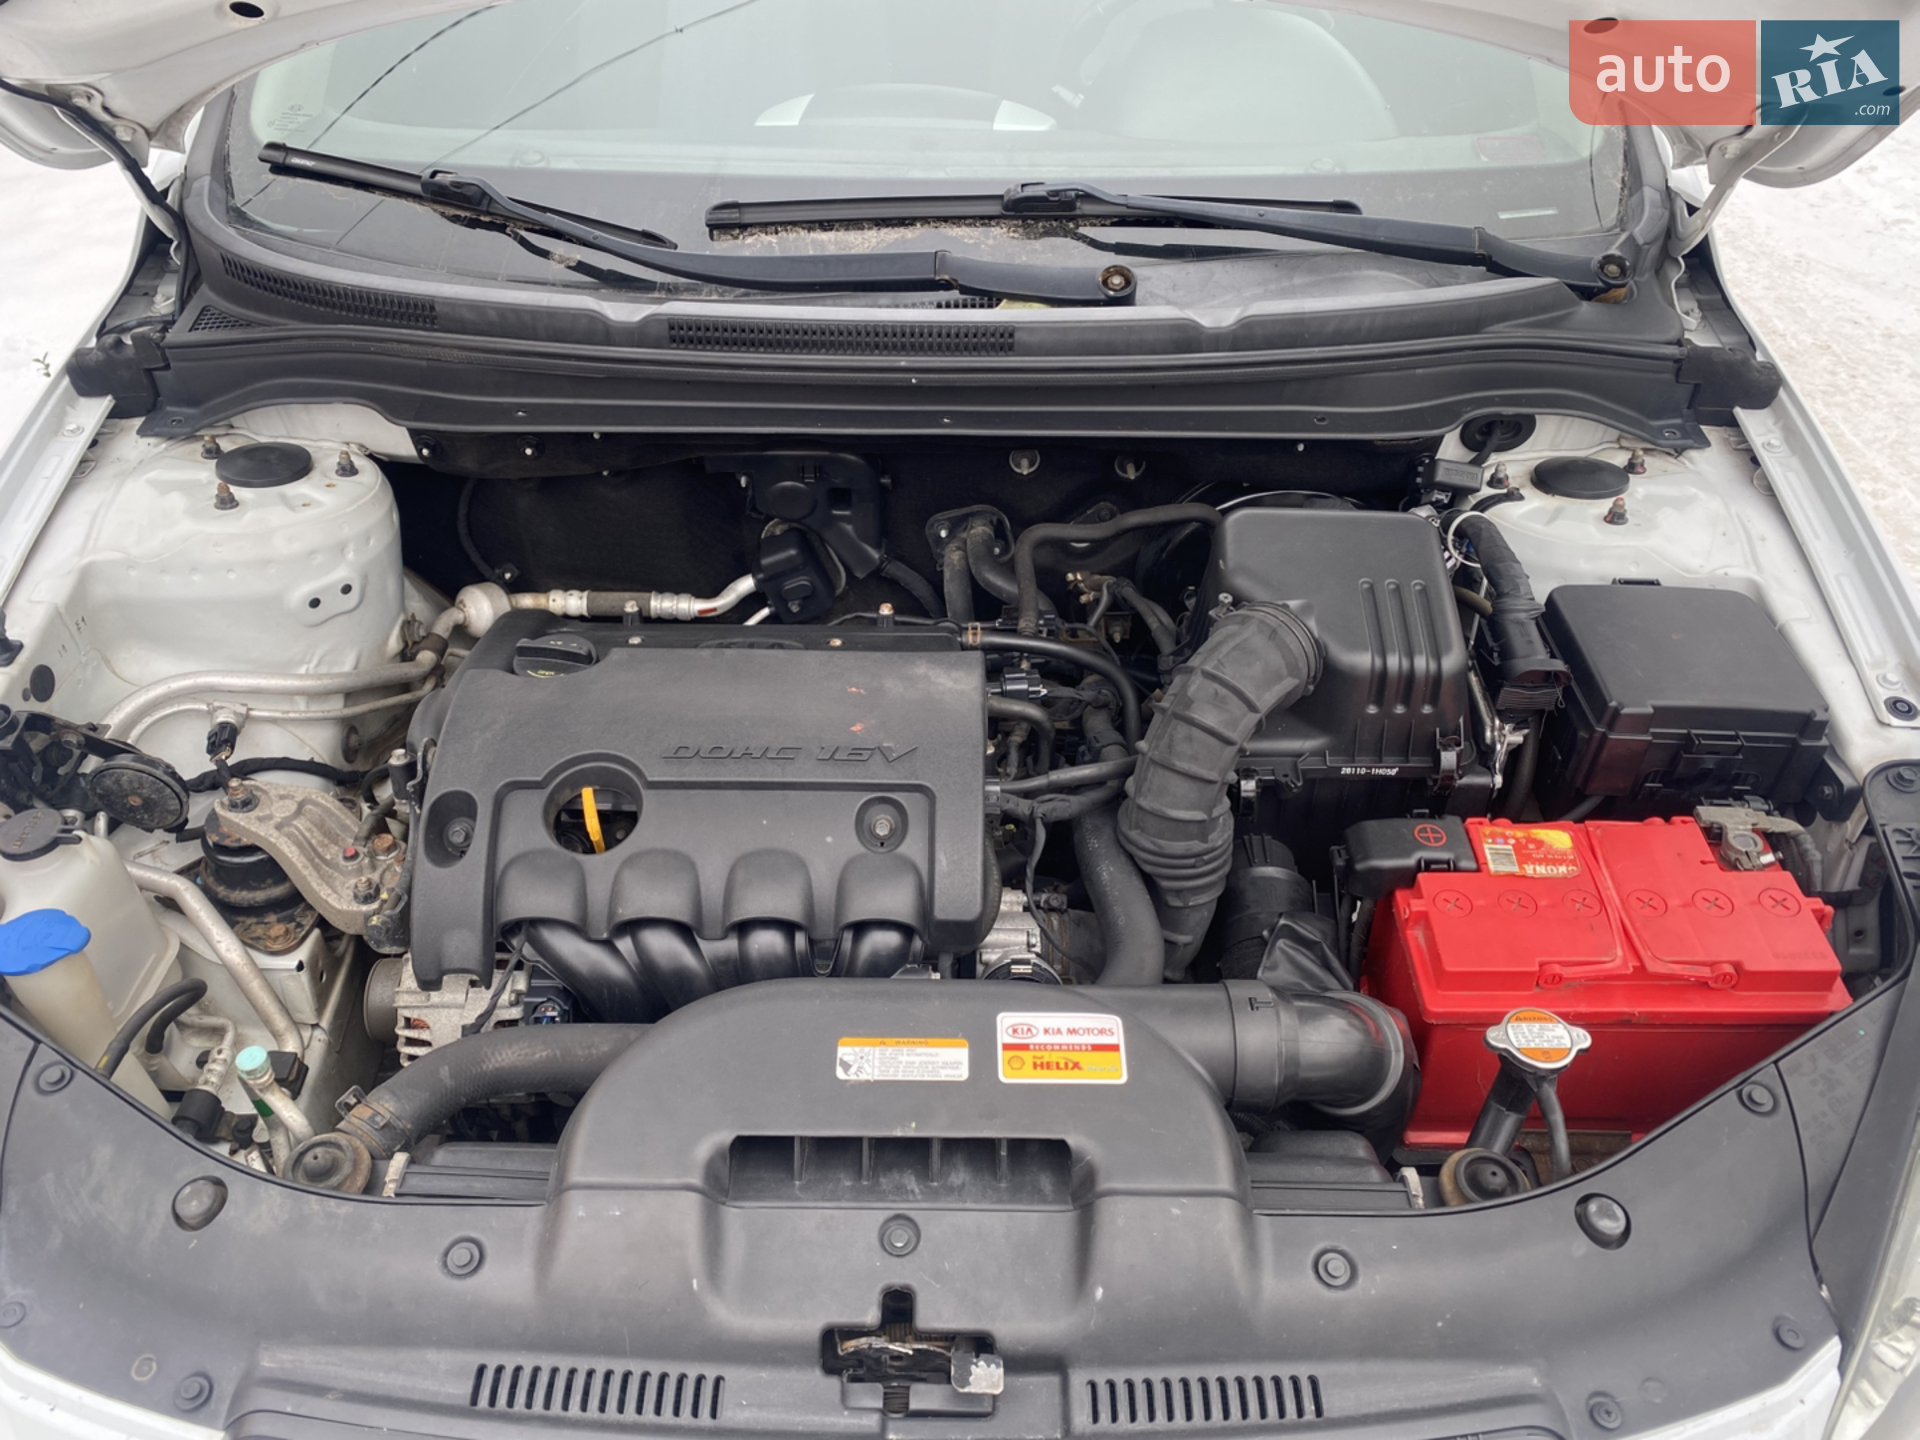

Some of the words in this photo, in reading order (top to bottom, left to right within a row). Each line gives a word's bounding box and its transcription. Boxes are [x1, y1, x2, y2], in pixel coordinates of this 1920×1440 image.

[662, 745, 802, 760] DOHC
[816, 745, 919, 763] 16V
[1011, 1027, 1034, 1036] KIA
[1043, 1027, 1063, 1036] KIA
[1066, 1027, 1115, 1037] MOTORS
[1032, 1061, 1083, 1071] HELIX
